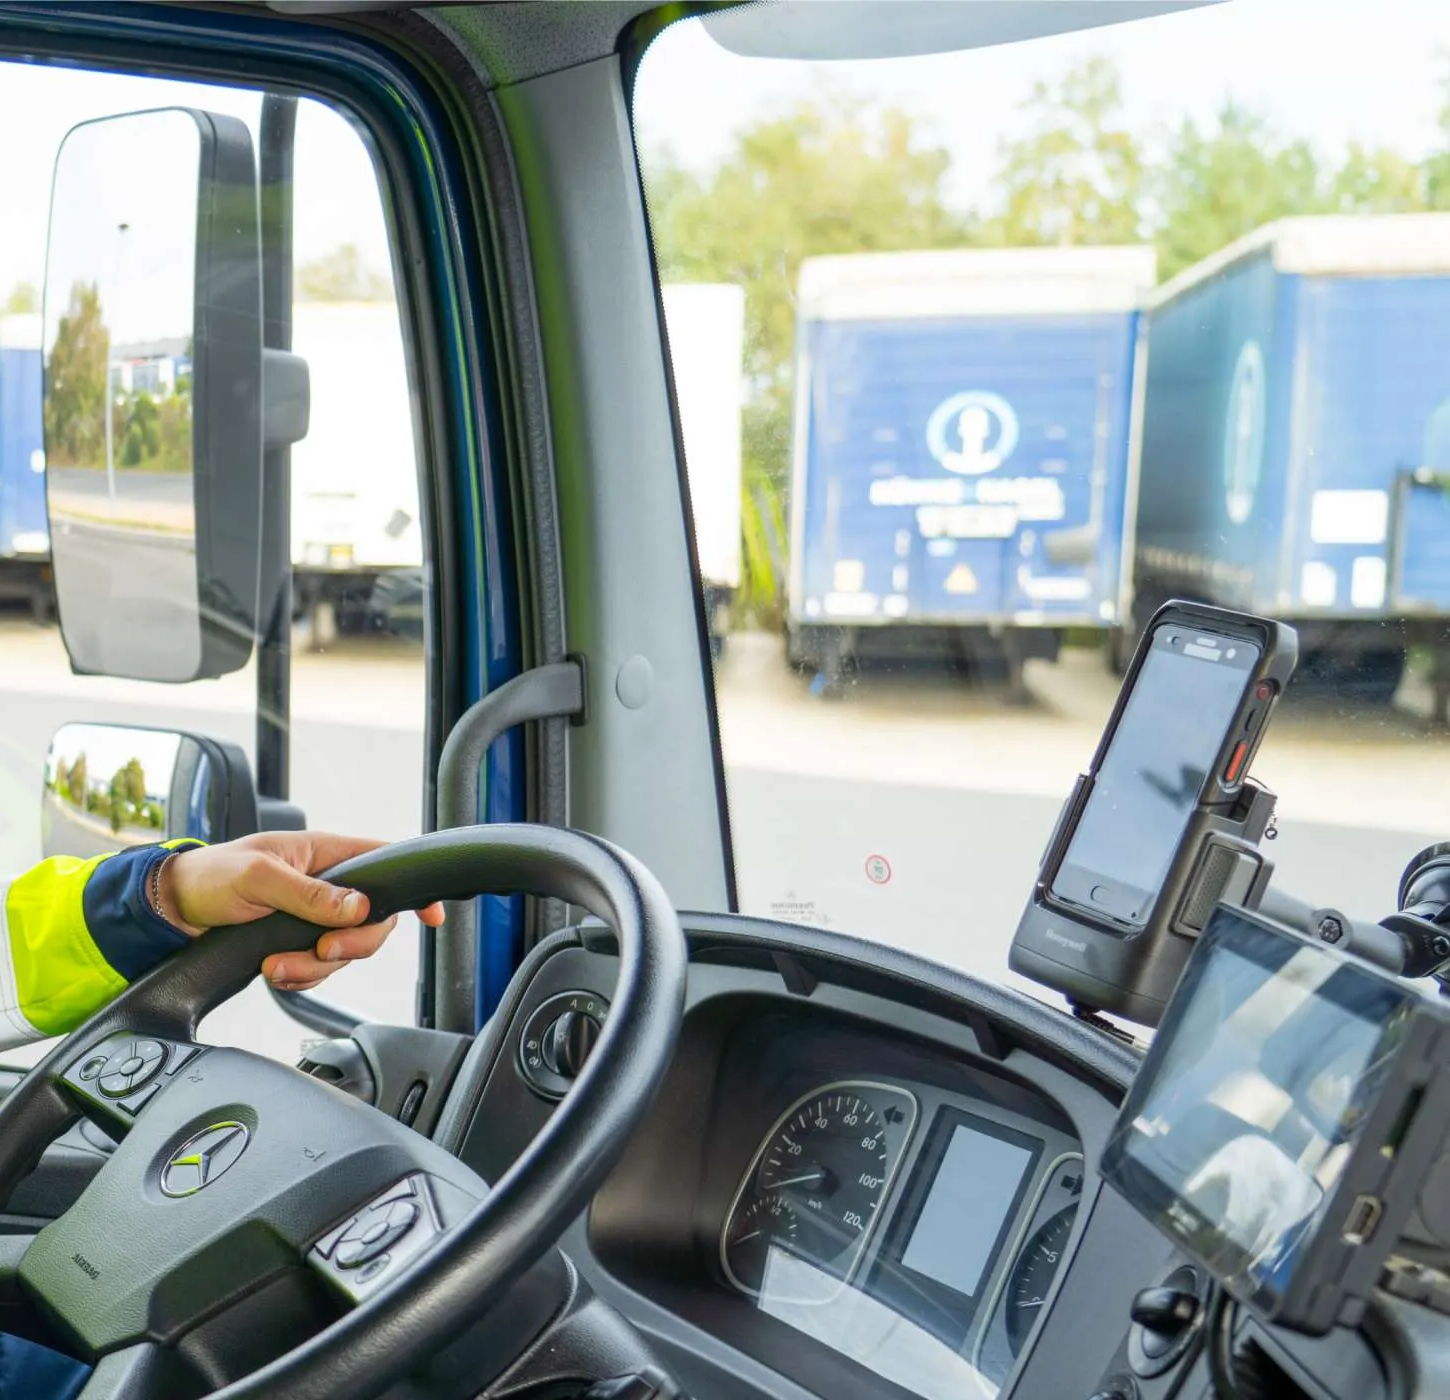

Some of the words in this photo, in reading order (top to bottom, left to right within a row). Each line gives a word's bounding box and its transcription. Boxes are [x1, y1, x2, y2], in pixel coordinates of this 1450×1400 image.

[570, 999, 577, 1008] A
[815, 1117, 828, 1129] 40
[843, 1114, 858, 1126] 60
[788, 1143, 802, 1155] 20
[861, 1137, 876, 1150] 80
[858, 1173, 877, 1188] 100
[843, 1211, 861, 1226] 120
[1046, 1250, 1058, 1263] 5
